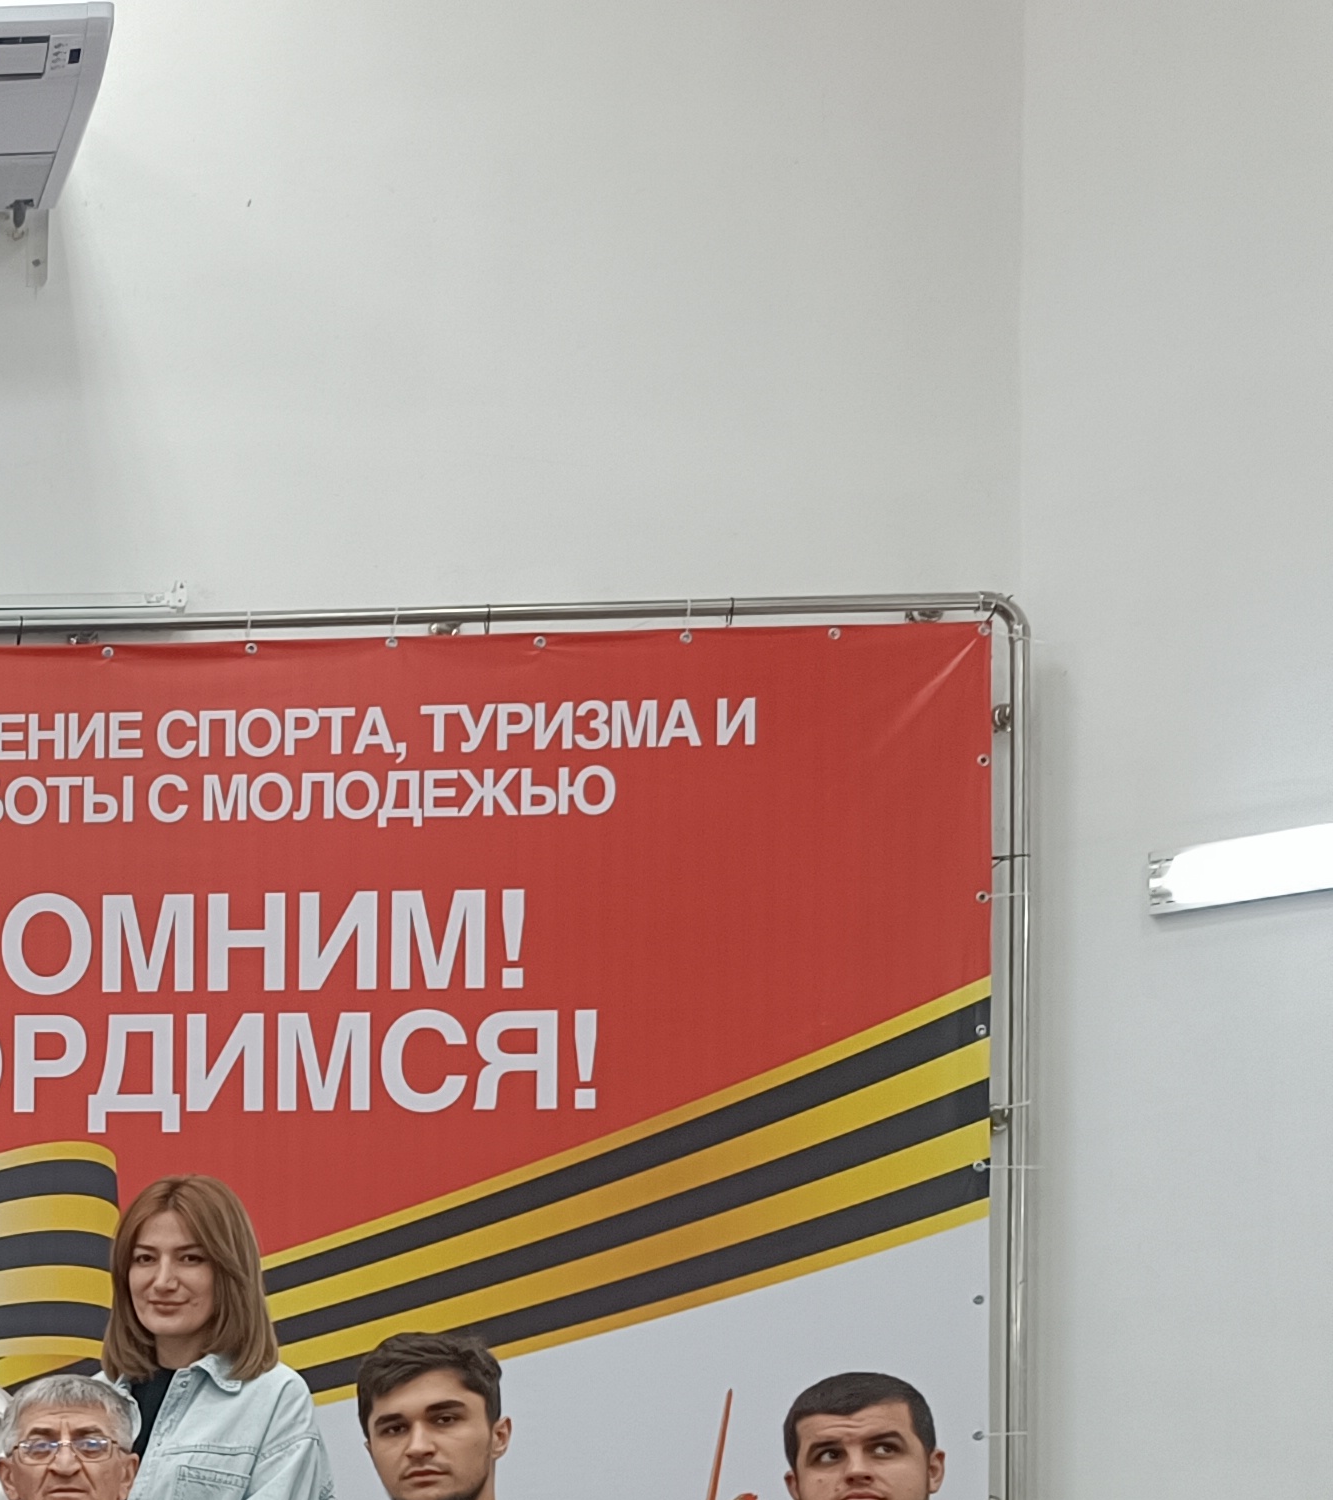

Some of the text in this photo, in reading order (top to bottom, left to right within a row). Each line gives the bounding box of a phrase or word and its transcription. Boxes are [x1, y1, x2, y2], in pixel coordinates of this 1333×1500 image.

[156, 706, 407, 764] СПОРТА,
[419, 698, 702, 753] ТУРИЗМА
[716, 697, 756, 747] И
[148, 773, 189, 823] С
[202, 764, 616, 828] МОЛОДЕЖЬЮ
